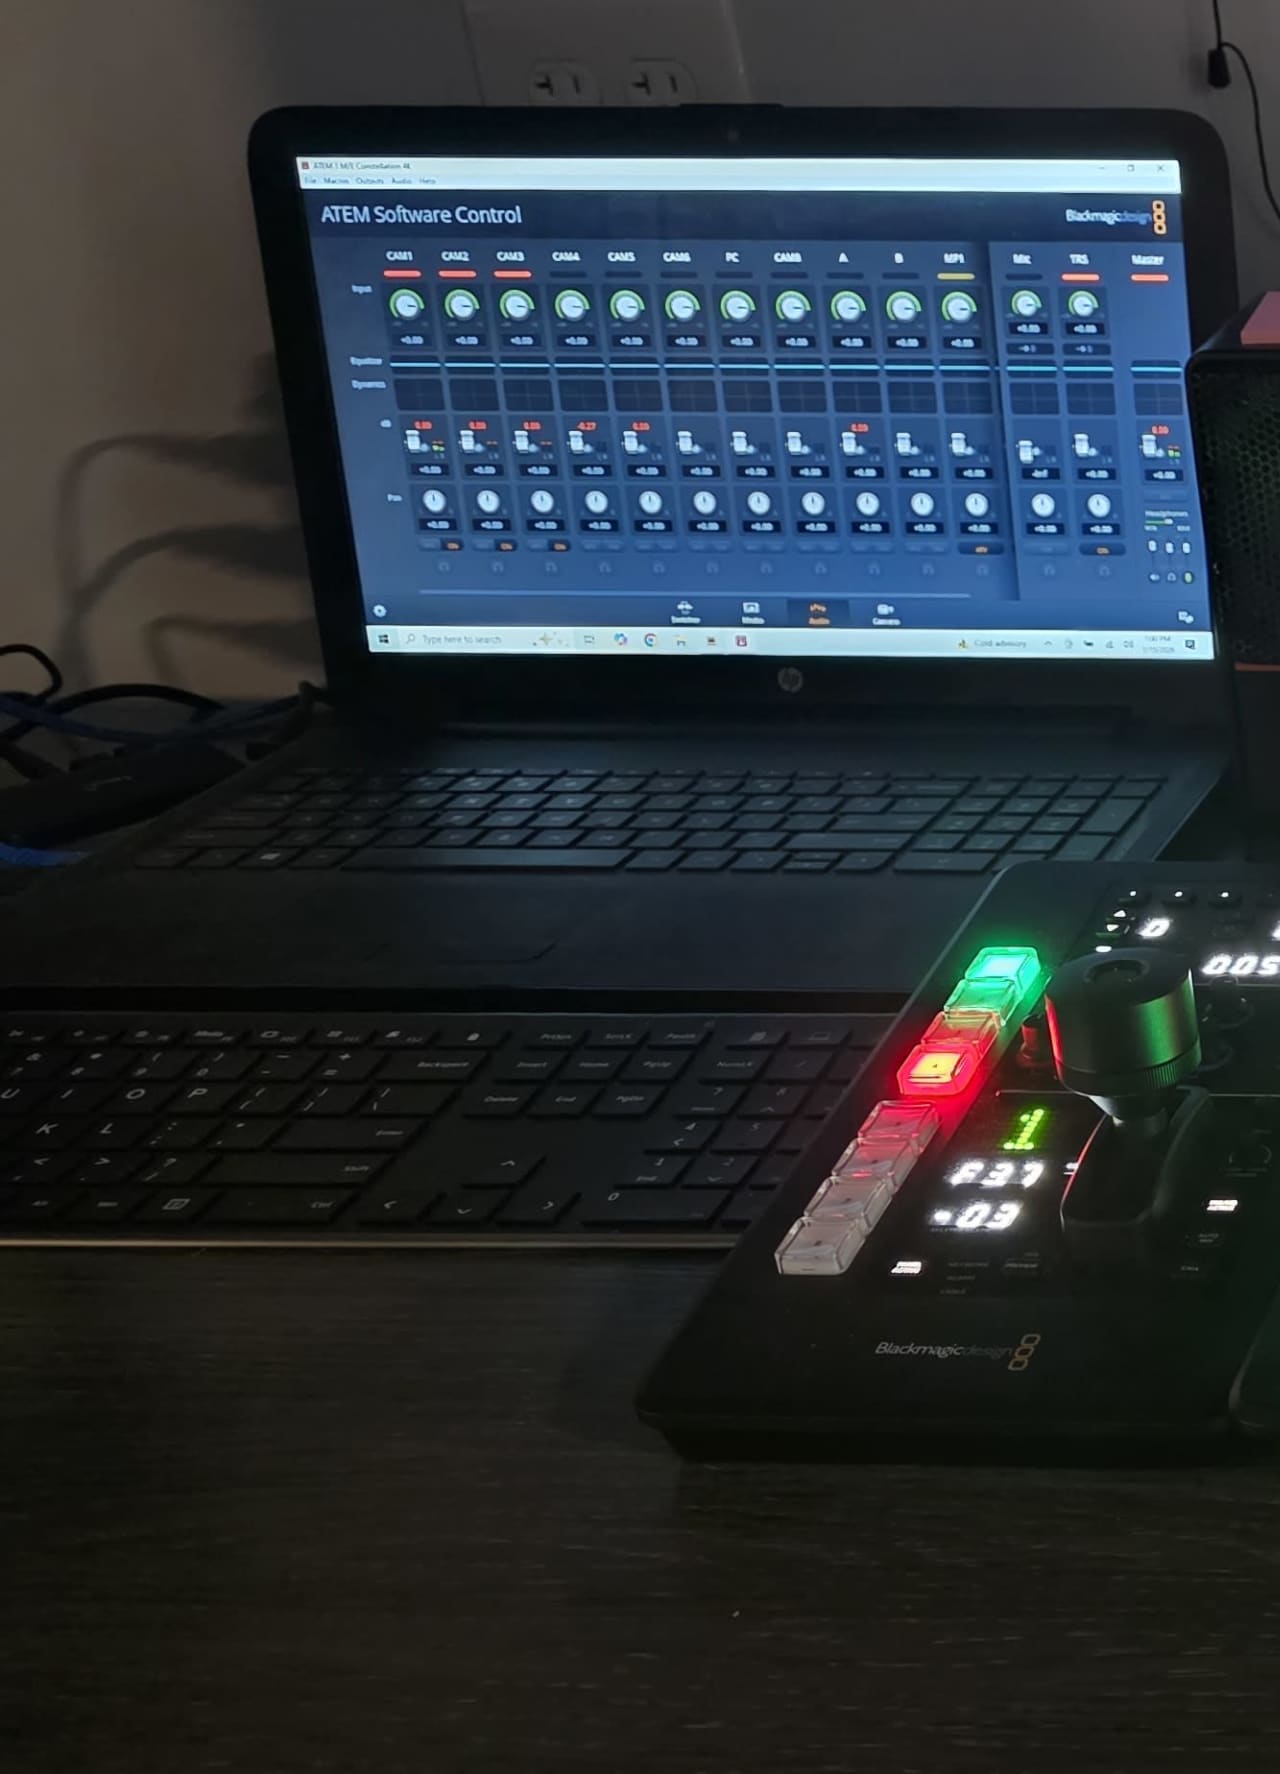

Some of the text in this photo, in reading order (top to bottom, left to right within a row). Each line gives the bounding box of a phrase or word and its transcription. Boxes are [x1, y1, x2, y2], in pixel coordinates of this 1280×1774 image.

[321, 205, 522, 223] ATEM Software Control
[1003, 1108, 1045, 1151] 1
